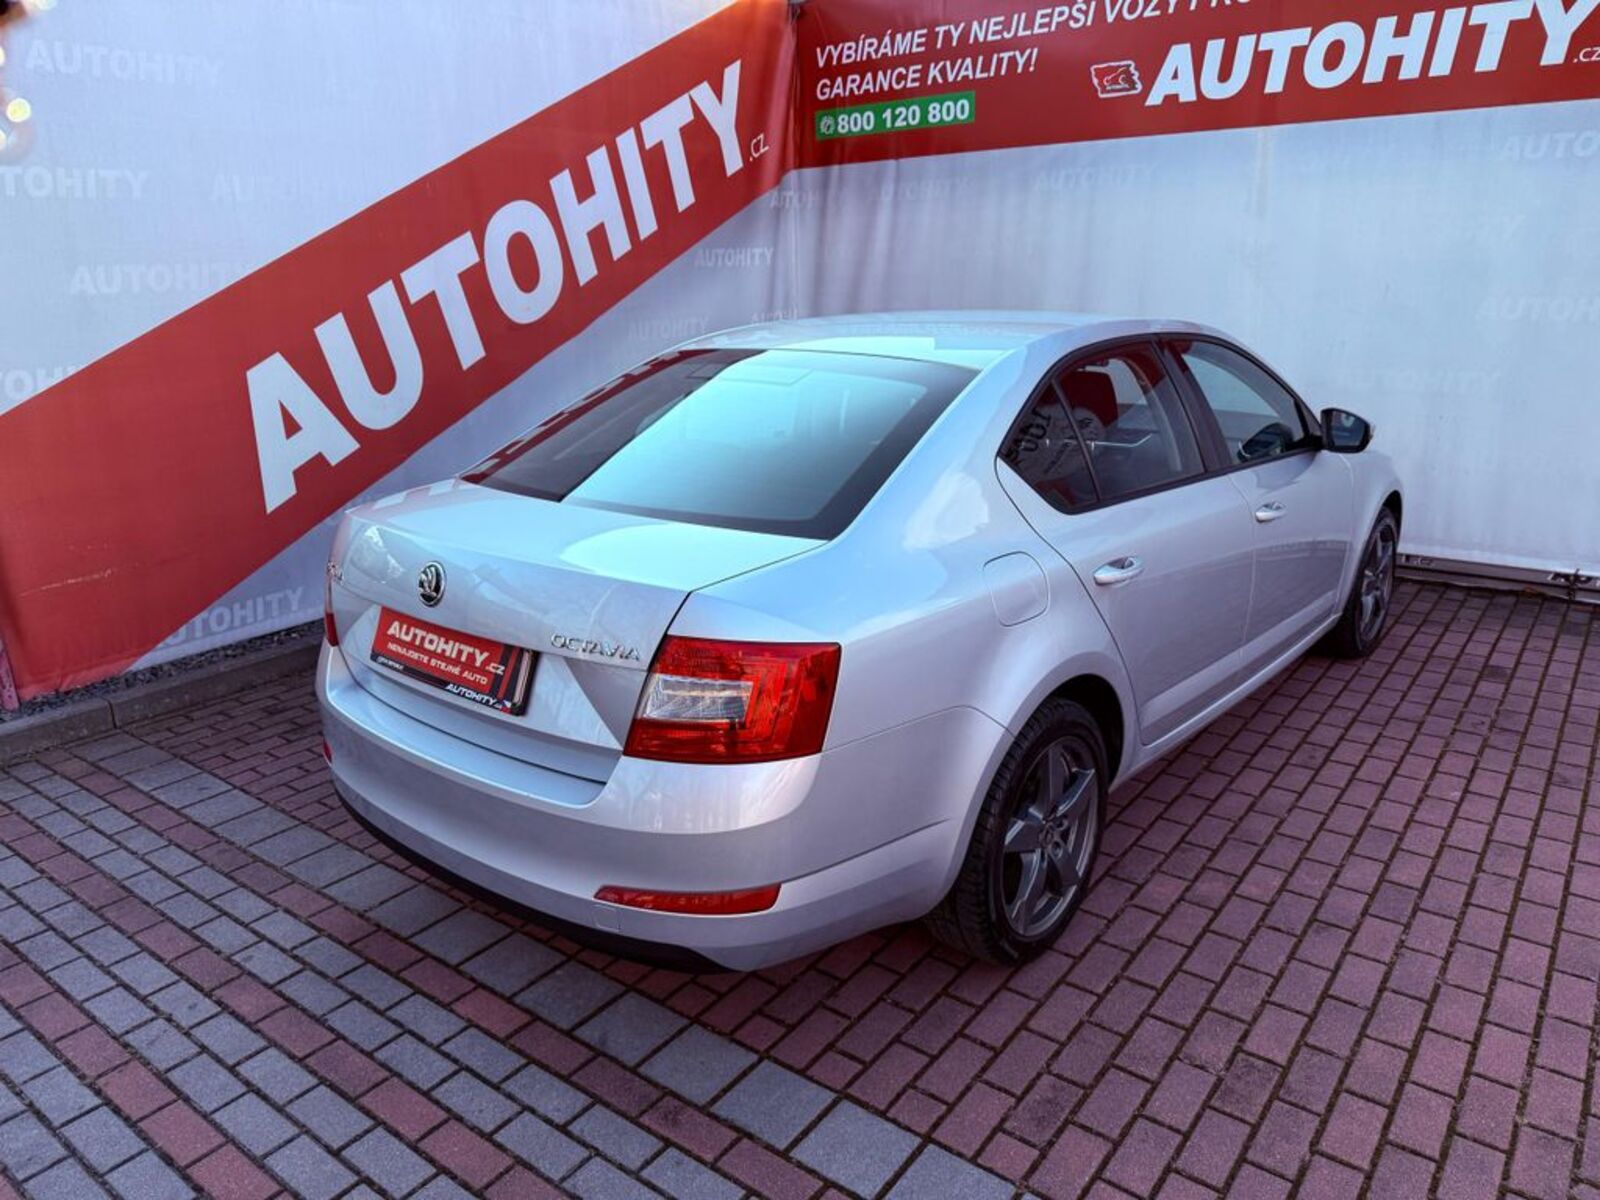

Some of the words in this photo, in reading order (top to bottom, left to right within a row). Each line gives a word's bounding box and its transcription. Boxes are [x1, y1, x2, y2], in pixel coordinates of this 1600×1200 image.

[816, 29, 927, 68] VYBÍRÁME
[935, 22, 965, 48] TY
[1103, 0, 1179, 22] VOZY
[1144, 0, 1600, 107] AUTOHITY
[26, 39, 224, 87] AUTOHITY
[816, 65, 922, 101] GARANCE
[927, 48, 1038, 86] KVALITY!
[837, 112, 875, 134] 800
[882, 106, 920, 128] 120
[927, 100, 970, 123] 800
[695, 247, 773, 267] AUTOHITY
[246, 59, 744, 515] AUTOHITY
[387, 620, 490, 666] AUTOHITY
[551, 633, 640, 660] OCTAVIA
[445, 683, 496, 706] AUTOHITY
[462, 670, 488, 685] AUTO
